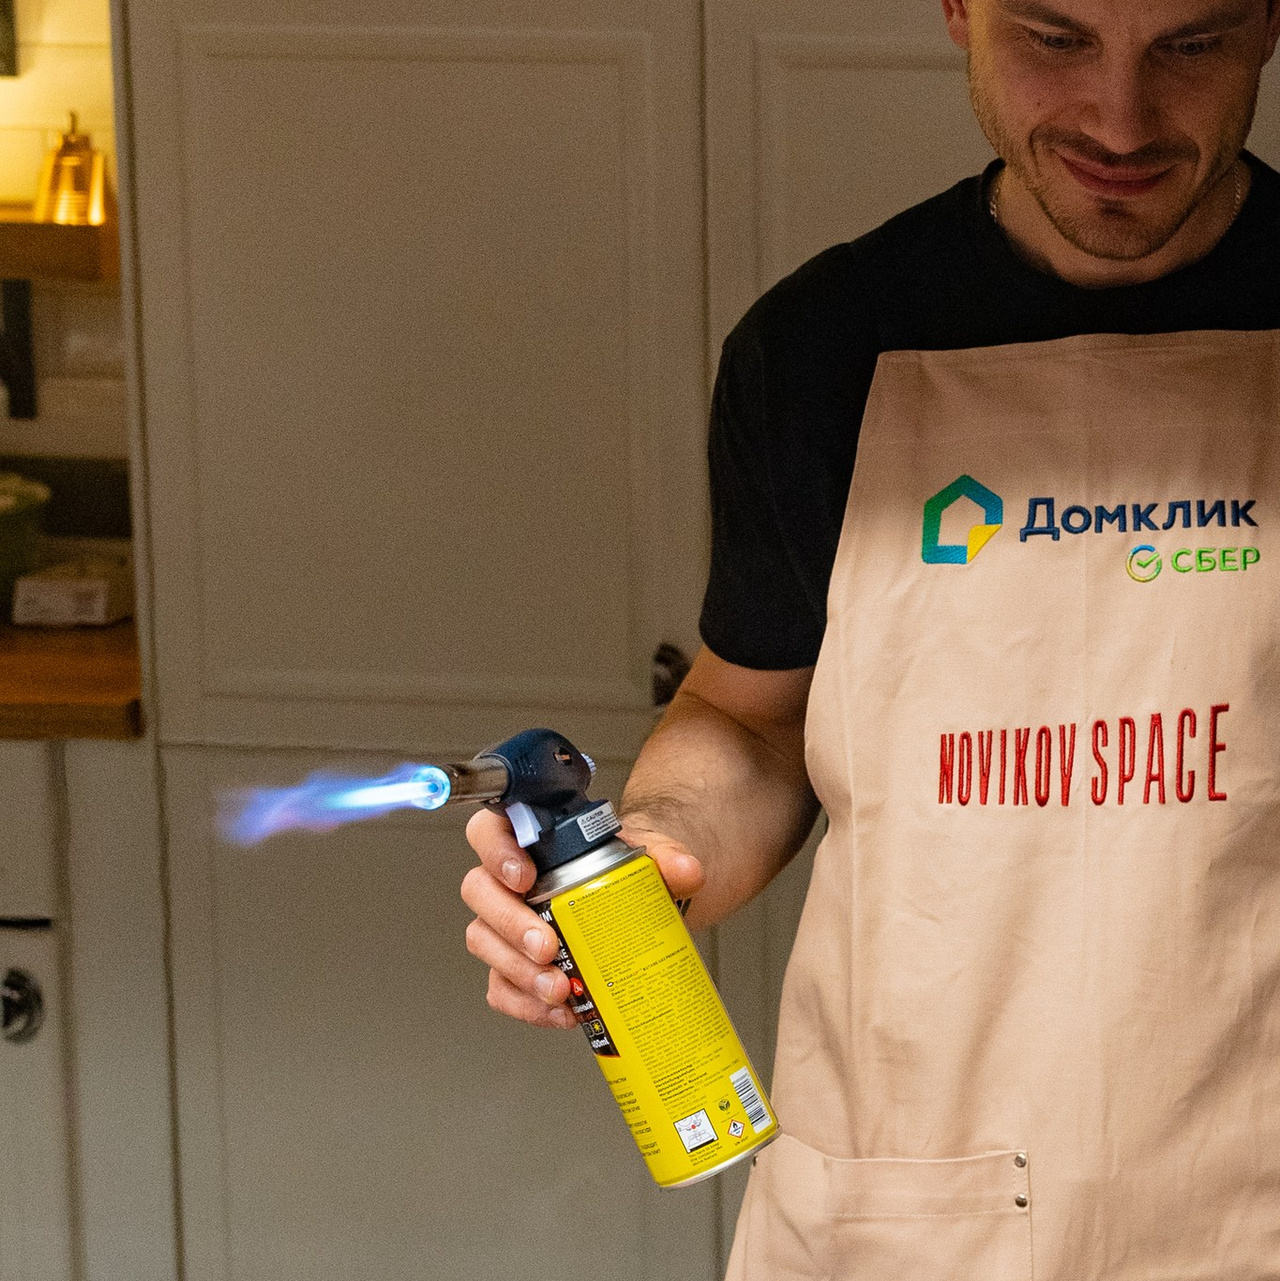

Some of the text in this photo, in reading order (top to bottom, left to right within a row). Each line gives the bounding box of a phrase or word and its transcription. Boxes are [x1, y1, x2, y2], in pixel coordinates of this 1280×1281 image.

[1019, 497, 1260, 543] Домклик
[1171, 546, 1261, 574] СБЕР
[938, 702, 1230, 808] NOVIKOV SPACE
